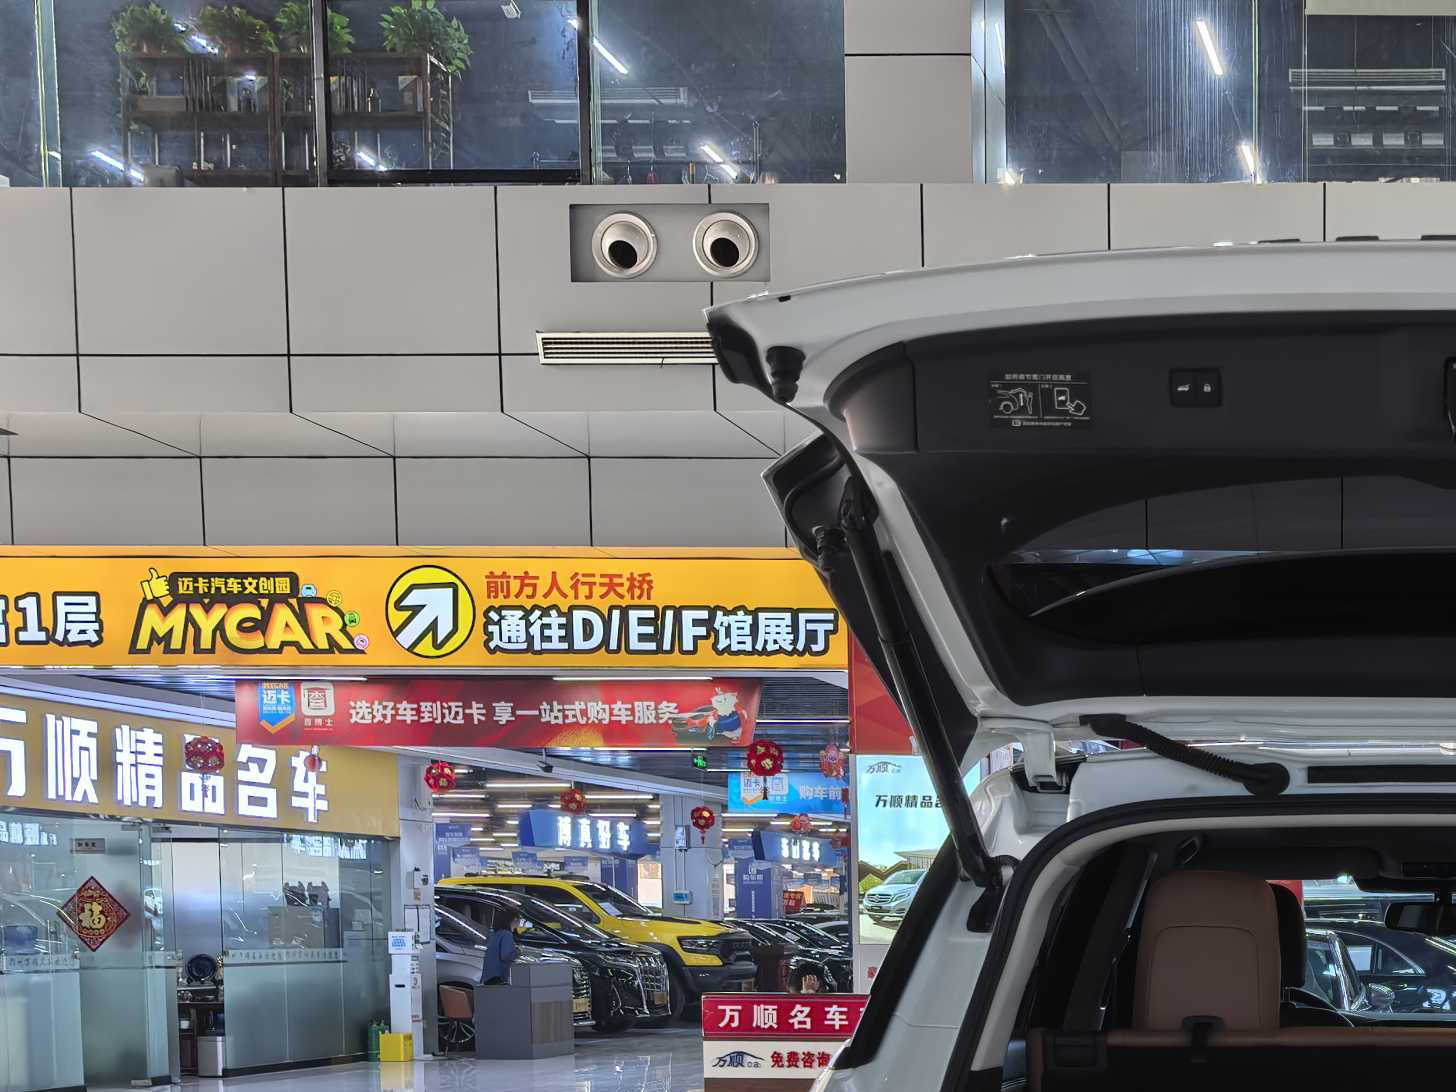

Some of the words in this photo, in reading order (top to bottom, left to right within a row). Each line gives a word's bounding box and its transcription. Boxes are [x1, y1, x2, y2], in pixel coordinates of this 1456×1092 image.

[178, 577, 291, 594] 迈卡汽车文创园
[485, 571, 655, 600] 前方人行天桥
[0, 593, 101, 645] 1层
[133, 602, 357, 654] MYCAR
[487, 608, 835, 652] 通往D/E/F馆展厅
[262, 689, 291, 705] 迈卡
[349, 700, 486, 725] 选好车到迈卡
[492, 700, 682, 725] 享一站式购车服务
[718, 1003, 865, 1030] 万顺名车
[771, 1050, 832, 1069] 免费咨询
